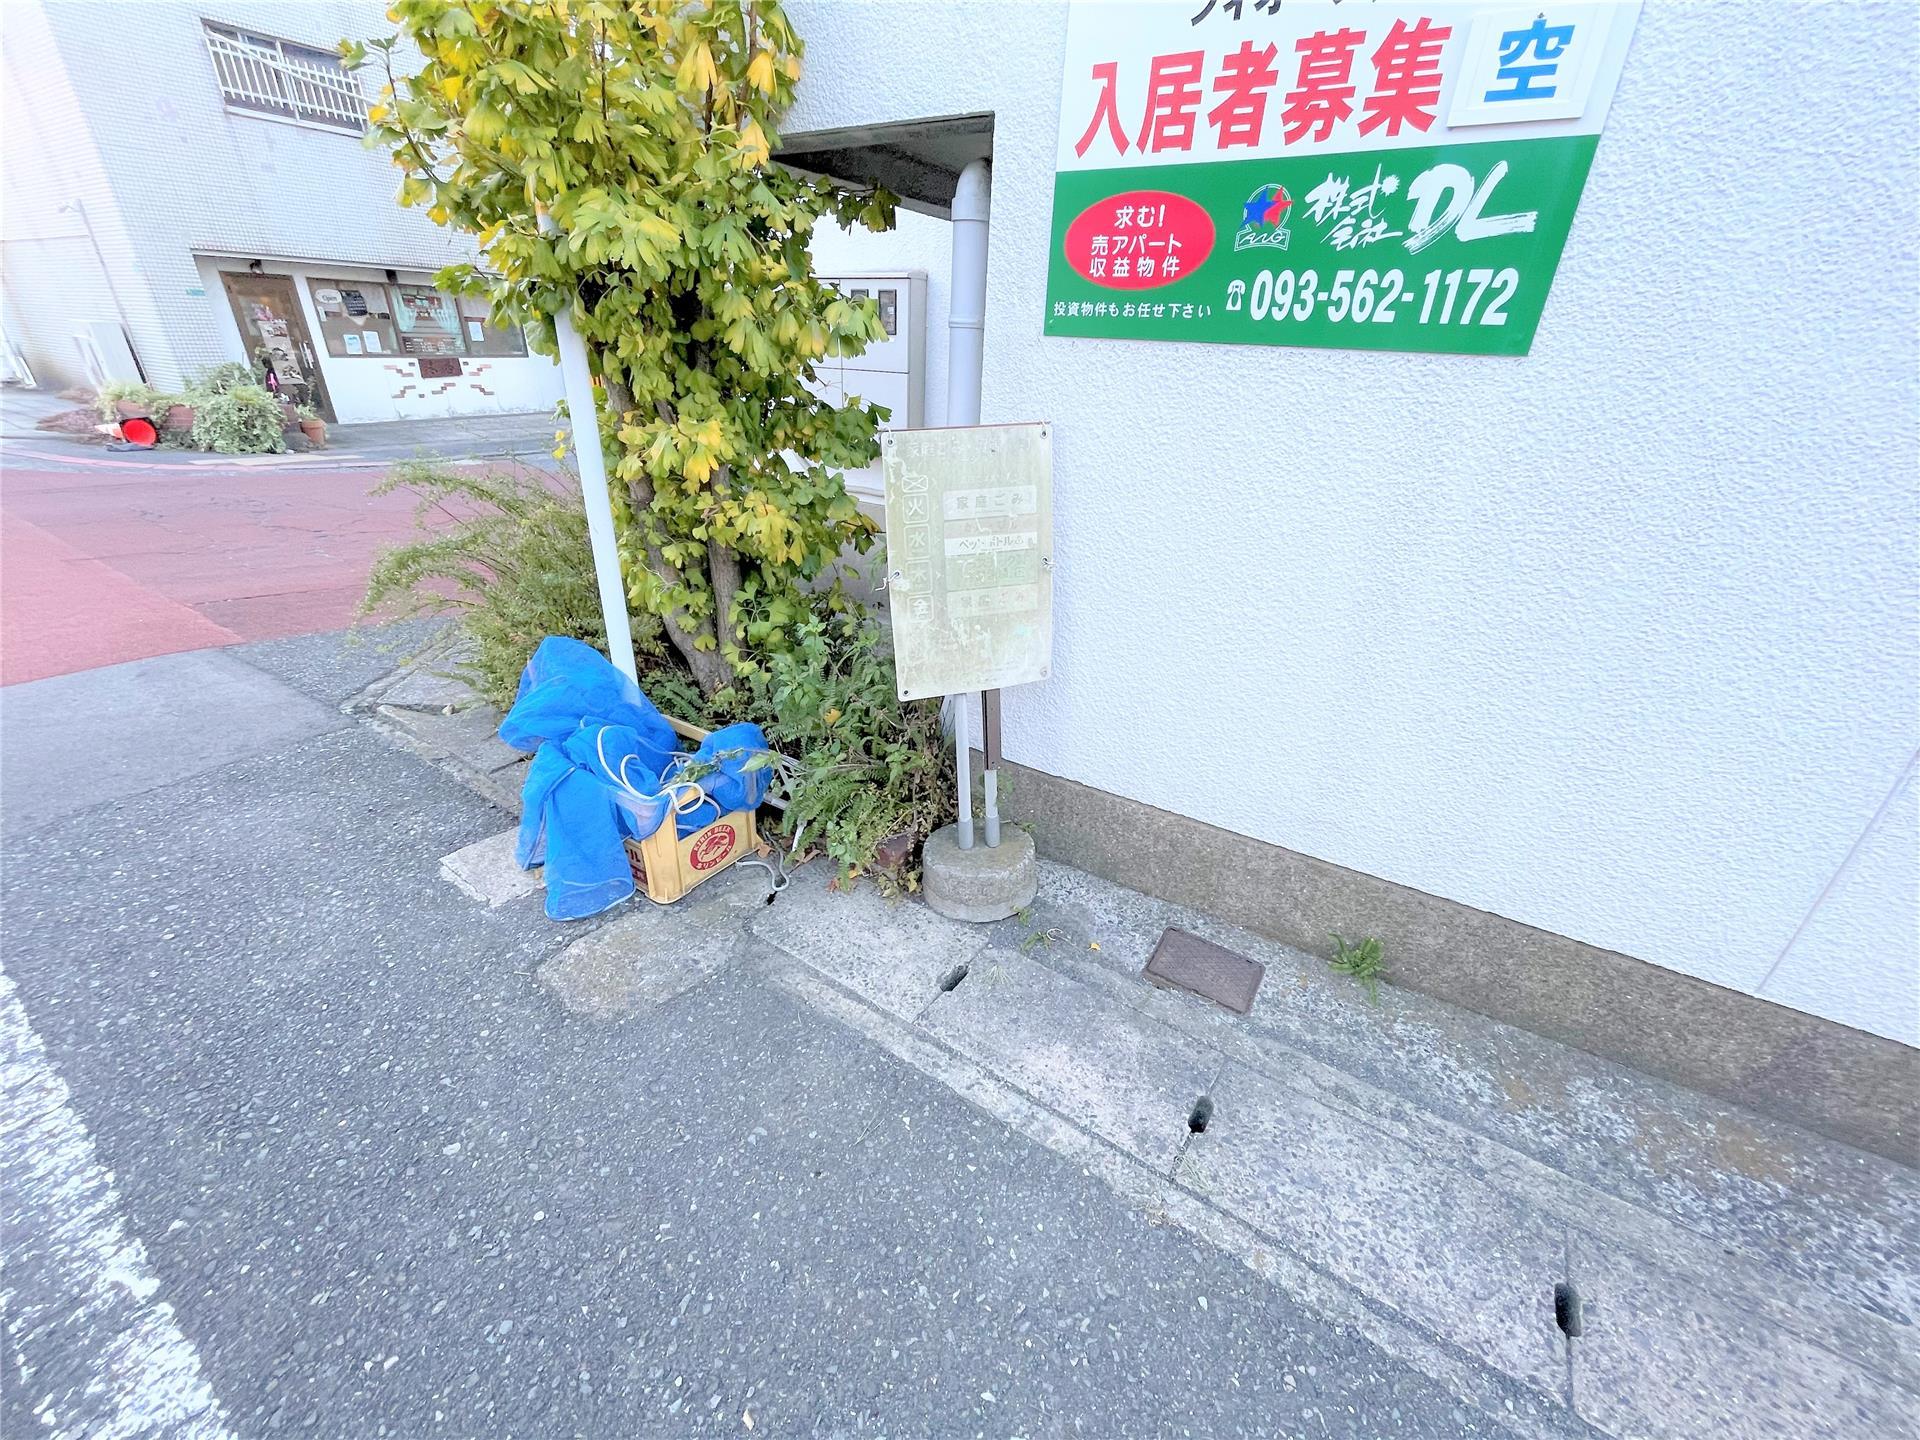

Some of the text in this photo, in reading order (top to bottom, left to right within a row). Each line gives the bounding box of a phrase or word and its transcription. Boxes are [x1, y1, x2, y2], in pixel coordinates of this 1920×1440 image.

[1484, 19, 1576, 102] 空
[1075, 17, 1452, 158] 入居者募集
[1402, 160, 1538, 255] DL
[1090, 233, 1183, 255] 売アパート
[1089, 256, 1181, 278] 収益物件
[1250, 267, 1519, 326] 093-562-1172
[1053, 301, 1212, 319] 投資物件もお任せ下さい
[908, 498, 924, 517] 火
[909, 531, 926, 548] 水
